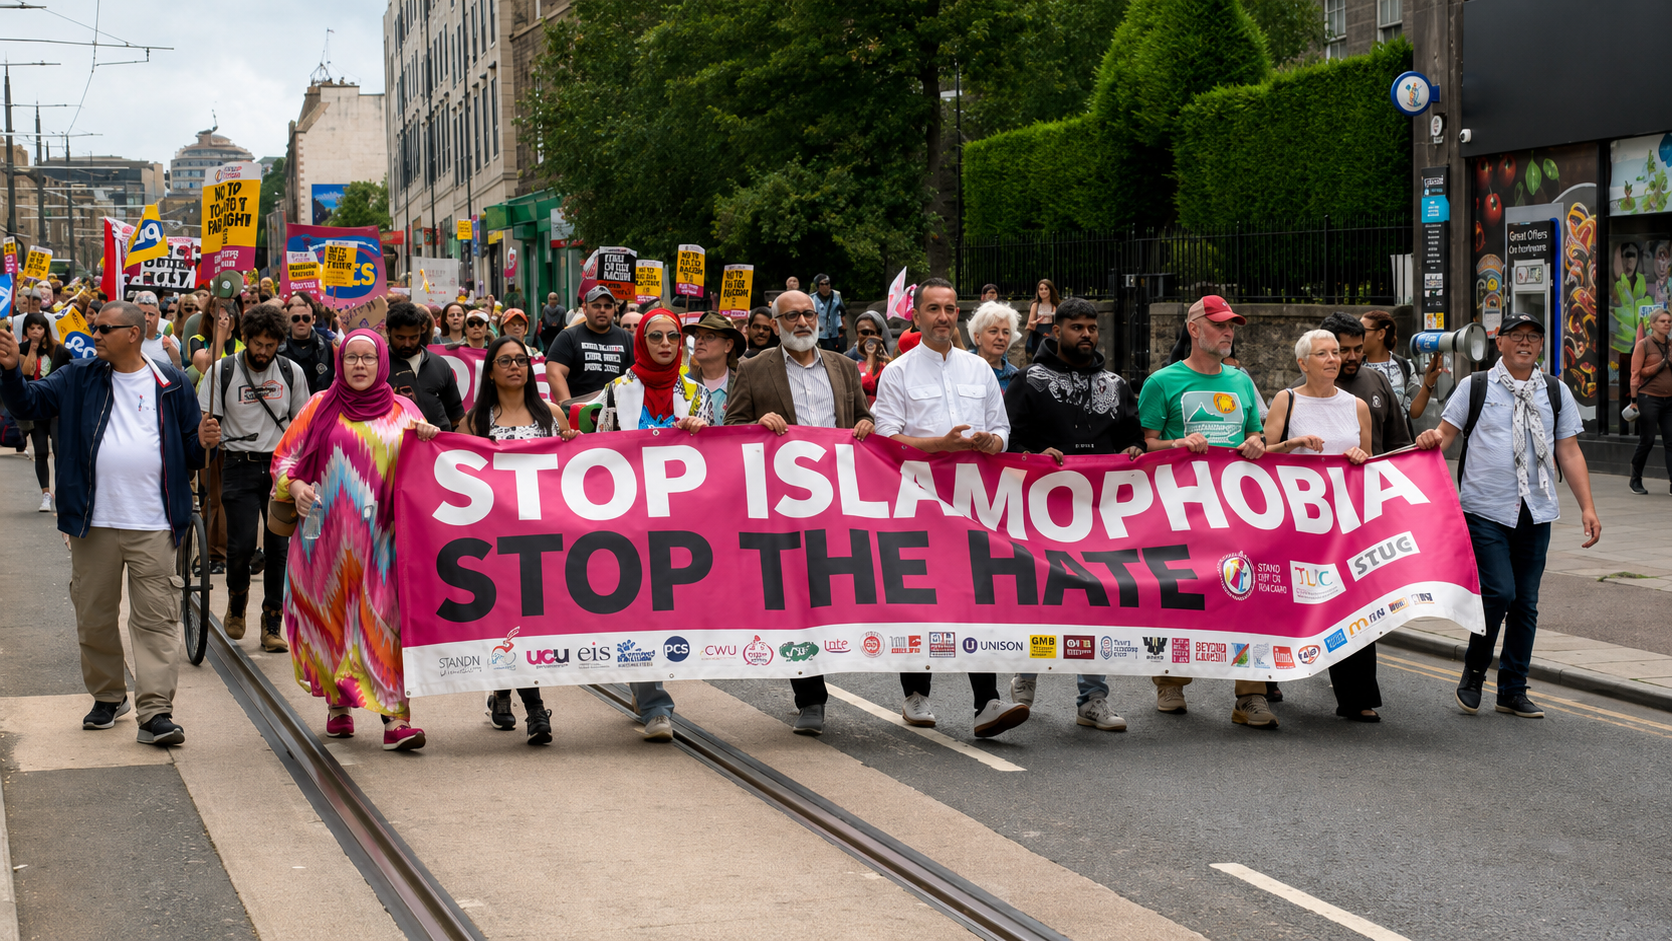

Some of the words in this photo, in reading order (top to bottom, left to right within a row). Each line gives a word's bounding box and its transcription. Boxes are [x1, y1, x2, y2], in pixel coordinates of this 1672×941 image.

[432, 445, 707, 526] STOP
[741, 440, 1431, 543] ISLAMOPHOBIA
[435, 530, 714, 623] STOP
[738, 528, 938, 610] THE
[967, 529, 1206, 611] HATE
[980, 641, 1024, 651] UNISON
[1031, 636, 1055, 646] GMB
[577, 642, 611, 661] eis
[704, 645, 737, 656] CWU
